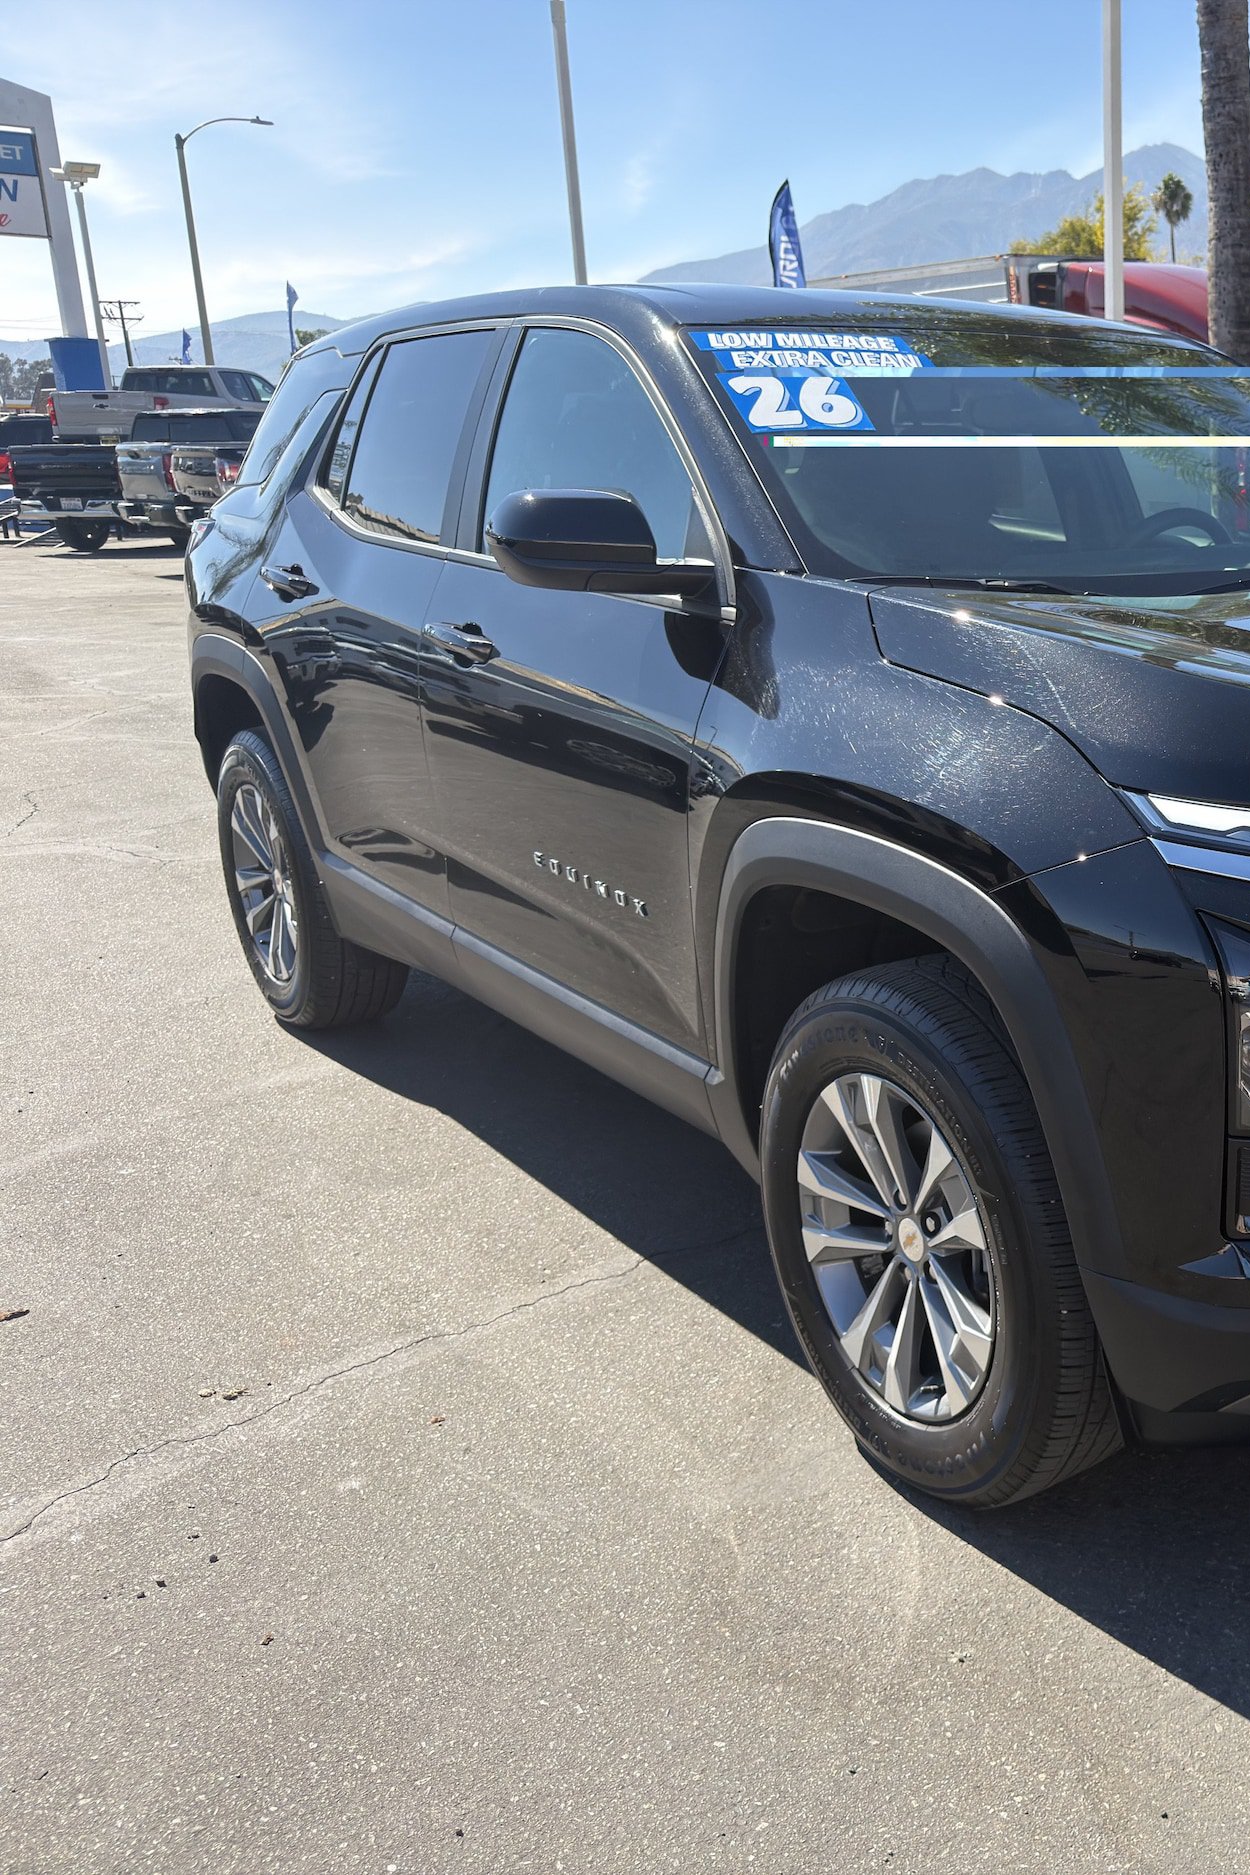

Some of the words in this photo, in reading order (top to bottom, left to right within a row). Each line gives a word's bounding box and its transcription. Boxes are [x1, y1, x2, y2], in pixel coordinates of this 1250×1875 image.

[707, 332, 773, 349] LOW
[774, 332, 899, 352] MILEAGE
[730, 350, 835, 367] EXTRA
[831, 351, 922, 367] CLEAN
[728, 376, 863, 429] 26
[533, 851, 646, 917] EQUINOX
